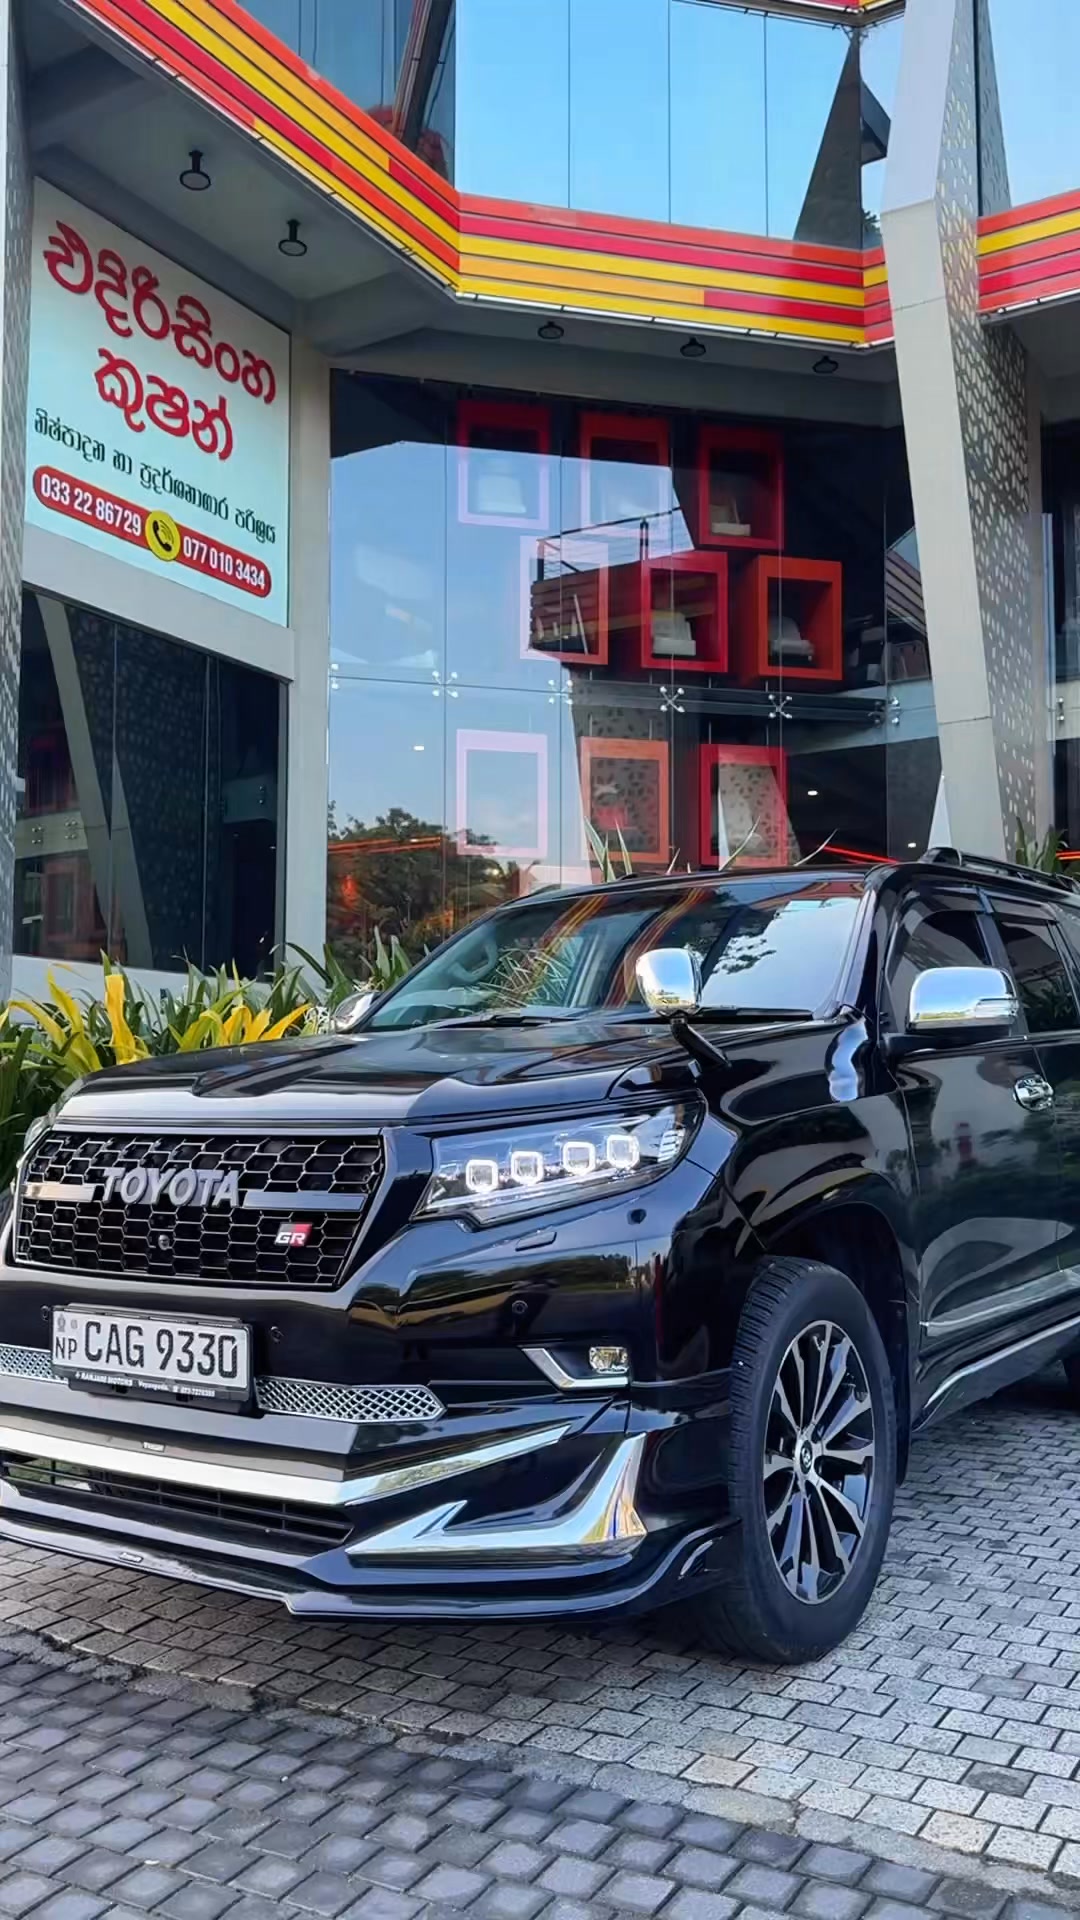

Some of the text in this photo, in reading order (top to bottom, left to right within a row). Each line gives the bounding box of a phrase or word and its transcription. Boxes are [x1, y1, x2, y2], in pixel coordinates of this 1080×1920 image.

[43, 220, 277, 405] එදිරිසිංහ
[94, 348, 234, 462] කුෂන්
[113, 449, 133, 475] හා
[40, 473, 142, 537] 033 22 86729
[183, 536, 266, 590] 077 010 3434
[102, 1167, 240, 1208] TOYOTA
[275, 1231, 306, 1246] GR
[55, 1336, 78, 1361] NP
[85, 1320, 237, 1380] CAG 9330
